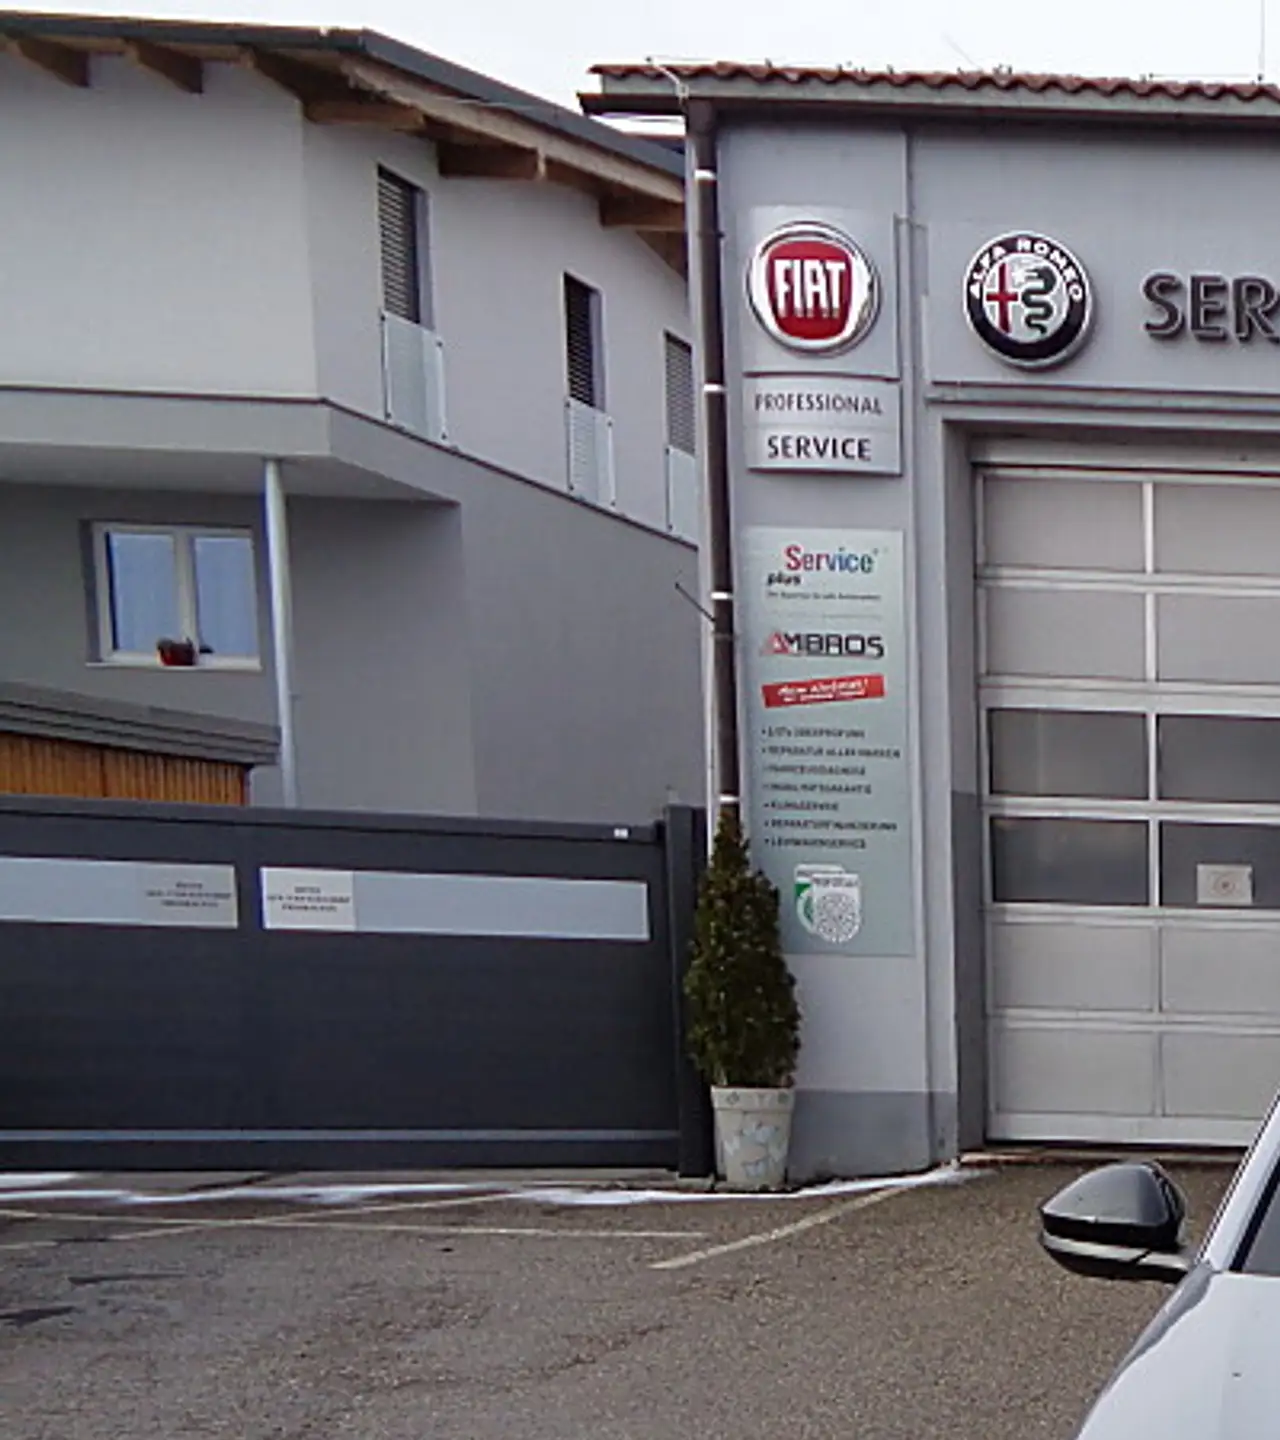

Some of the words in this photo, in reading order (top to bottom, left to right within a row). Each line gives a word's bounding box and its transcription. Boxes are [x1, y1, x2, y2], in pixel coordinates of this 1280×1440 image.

[774, 258, 845, 319] FIAT
[755, 393, 882, 416] PROFESSIONAL
[767, 436, 871, 461] SERVICE
[784, 545, 874, 573] Service
[761, 631, 884, 660] AMBROS
